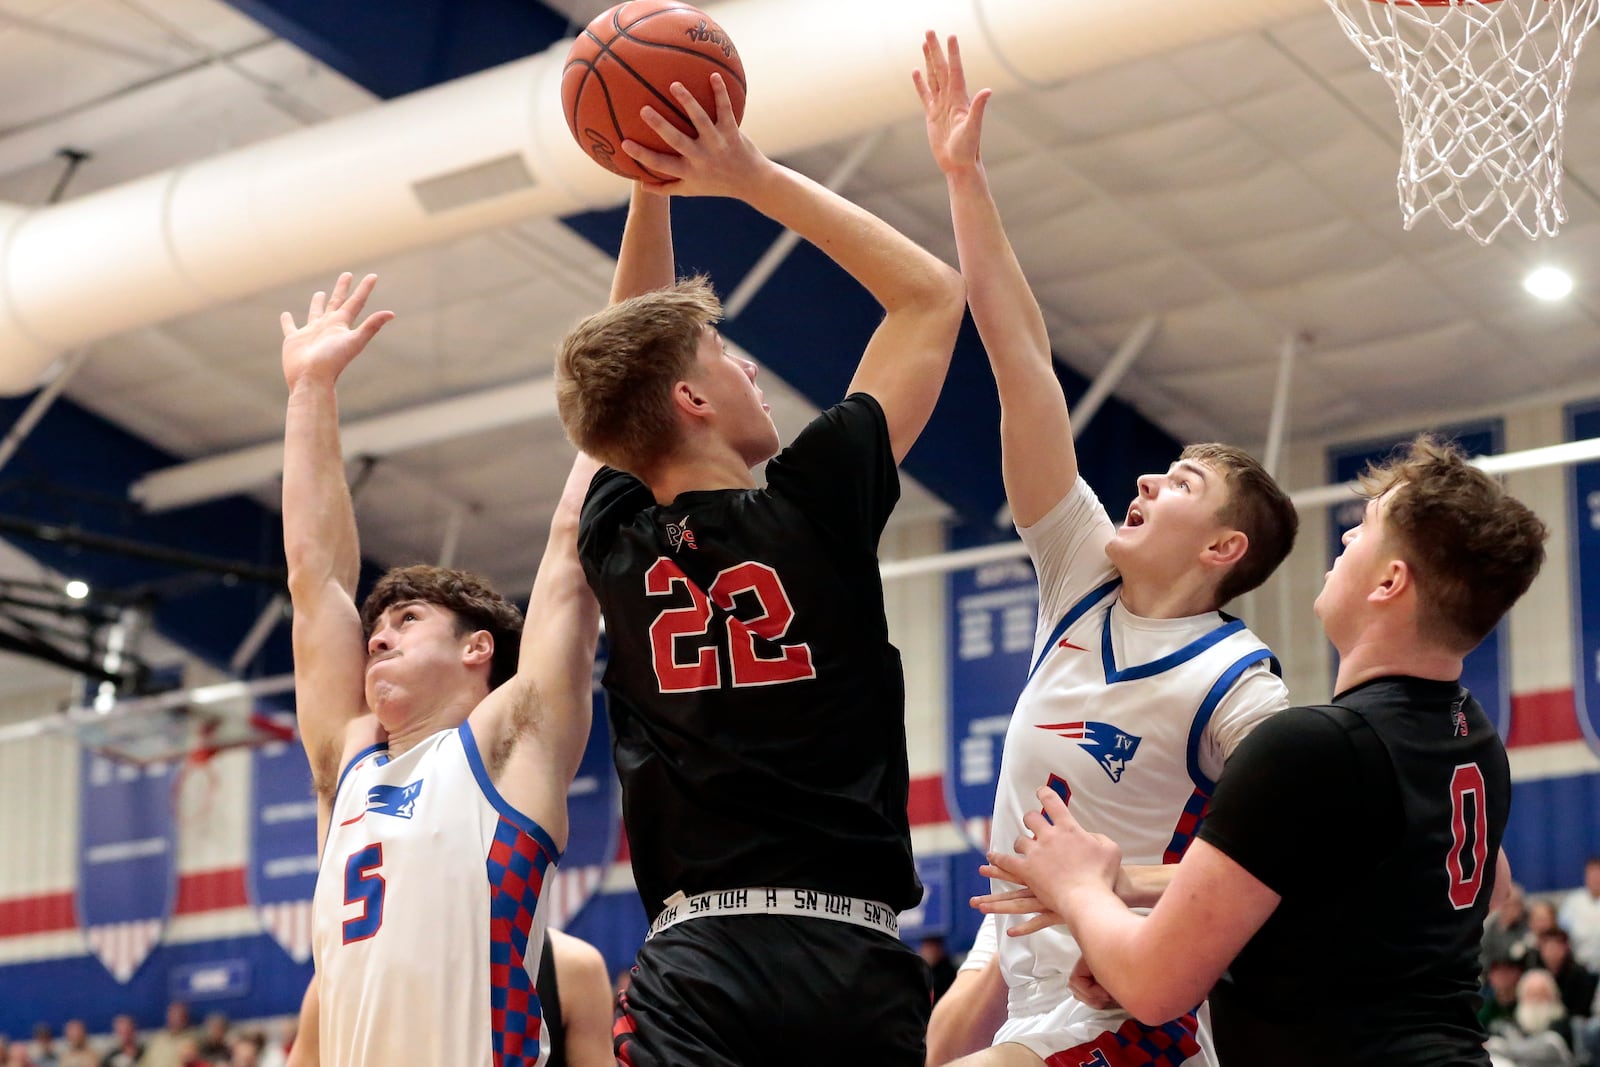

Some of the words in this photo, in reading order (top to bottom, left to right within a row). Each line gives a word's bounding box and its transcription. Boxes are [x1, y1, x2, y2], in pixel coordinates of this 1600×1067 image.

[645, 556, 817, 693] 22
[342, 842, 386, 946] 5
[1446, 761, 1488, 910] 0
